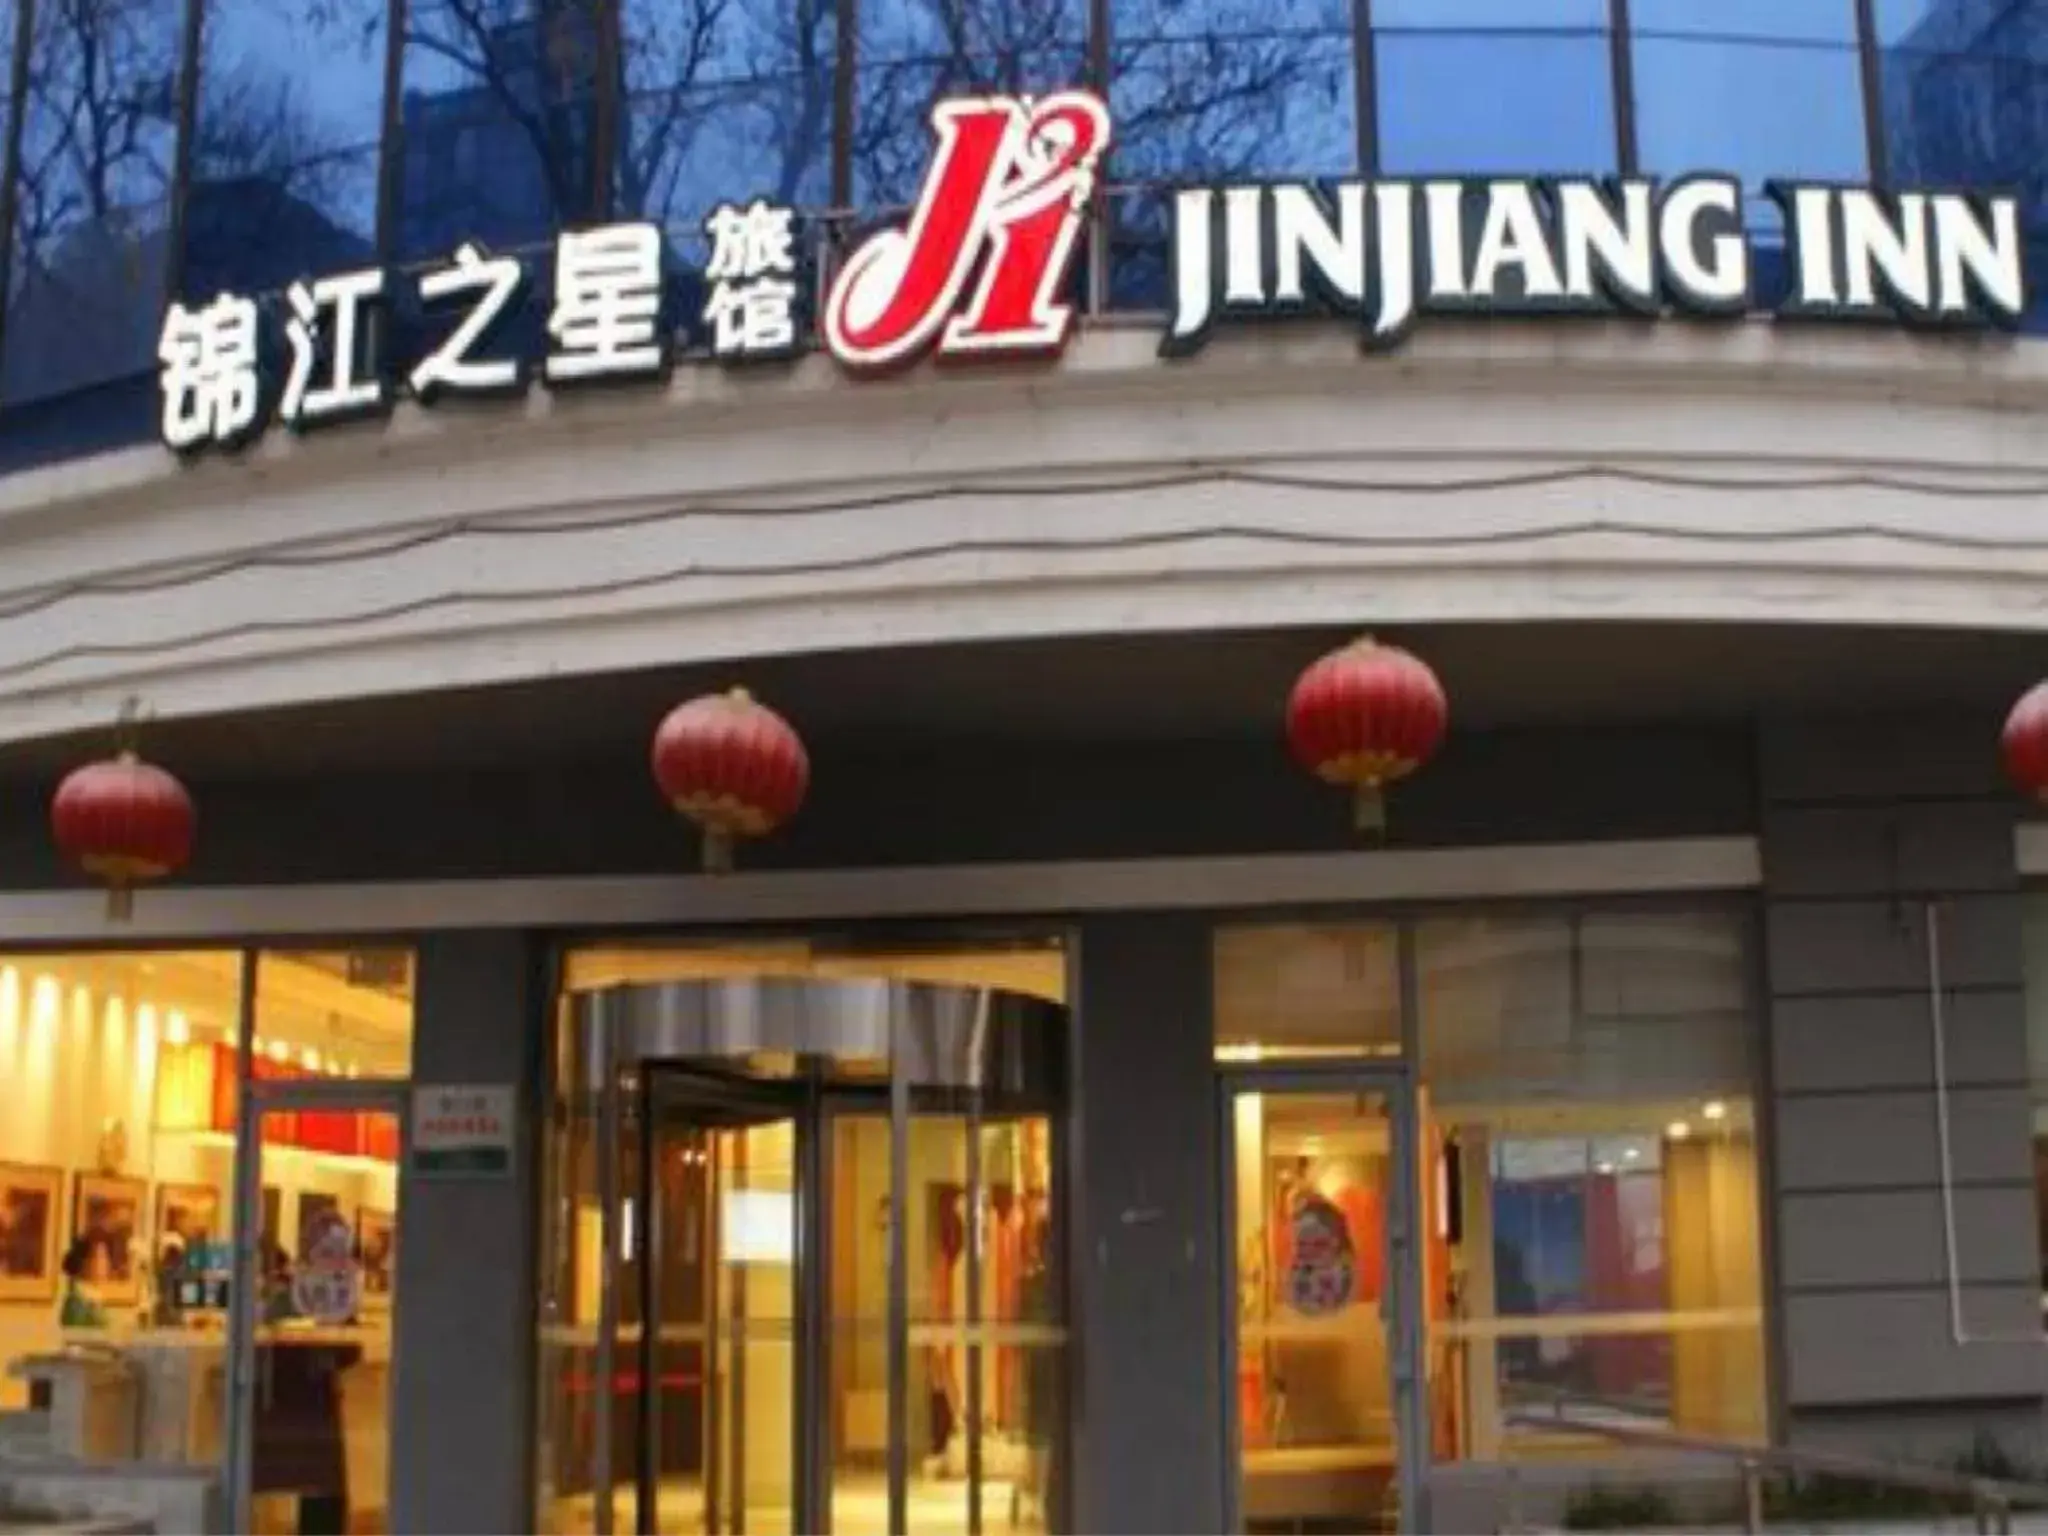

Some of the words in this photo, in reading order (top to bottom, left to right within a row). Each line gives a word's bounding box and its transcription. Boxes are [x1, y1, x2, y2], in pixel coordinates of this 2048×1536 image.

[157, 222, 664, 446] 锦江之星
[702, 200, 797, 354] 旅馆
[1174, 180, 1746, 337] JINJIANG
[1794, 188, 2023, 312] INN
